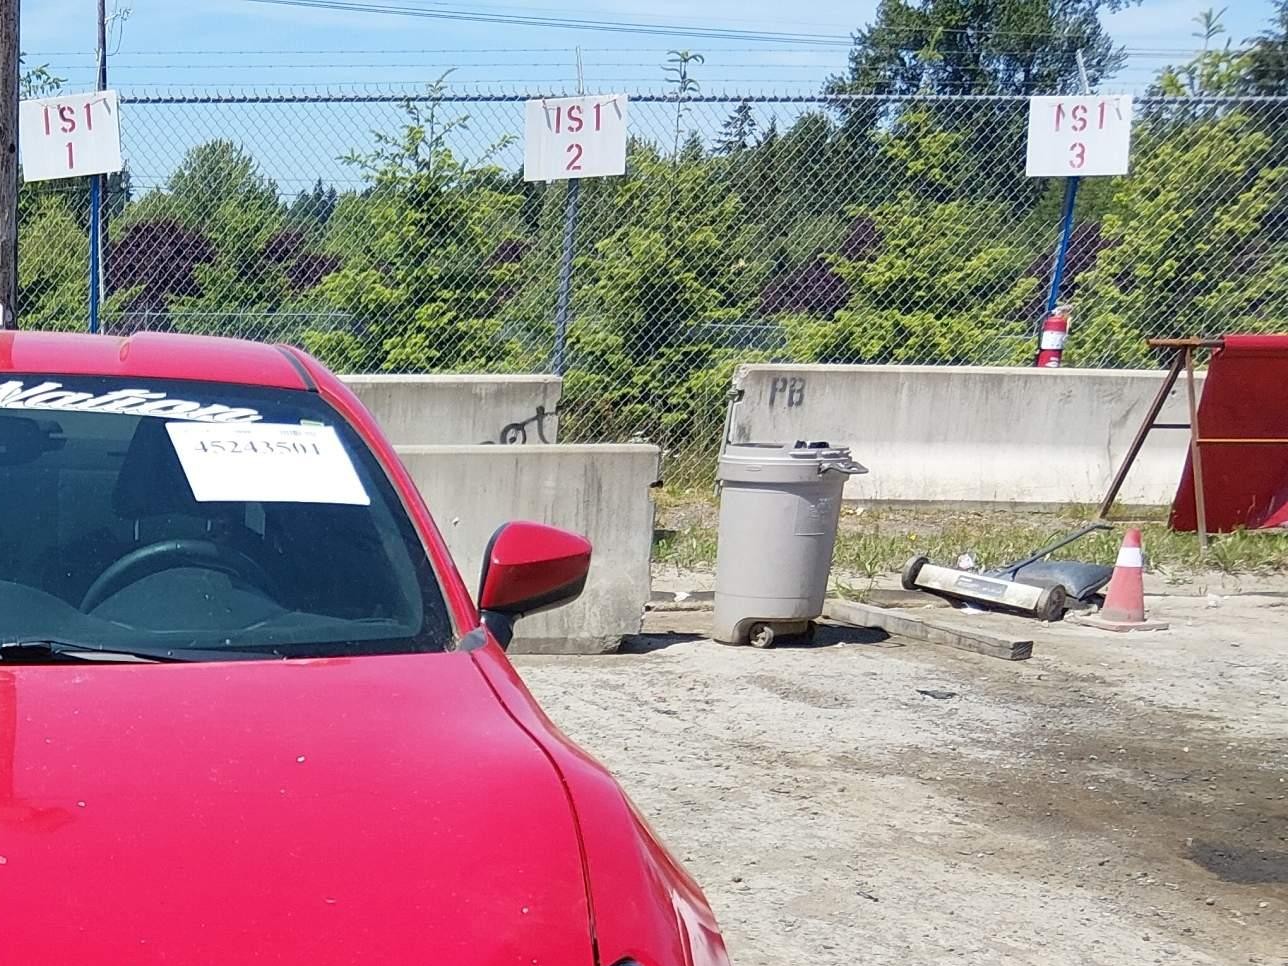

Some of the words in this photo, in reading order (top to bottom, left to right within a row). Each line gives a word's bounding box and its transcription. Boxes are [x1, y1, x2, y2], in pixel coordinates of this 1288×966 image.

[65, 142, 74, 169] 1
[566, 143, 583, 170] 2
[1069, 142, 1086, 168] 3
[768, 376, 806, 407] PB
[194, 440, 321, 456] 45243501
